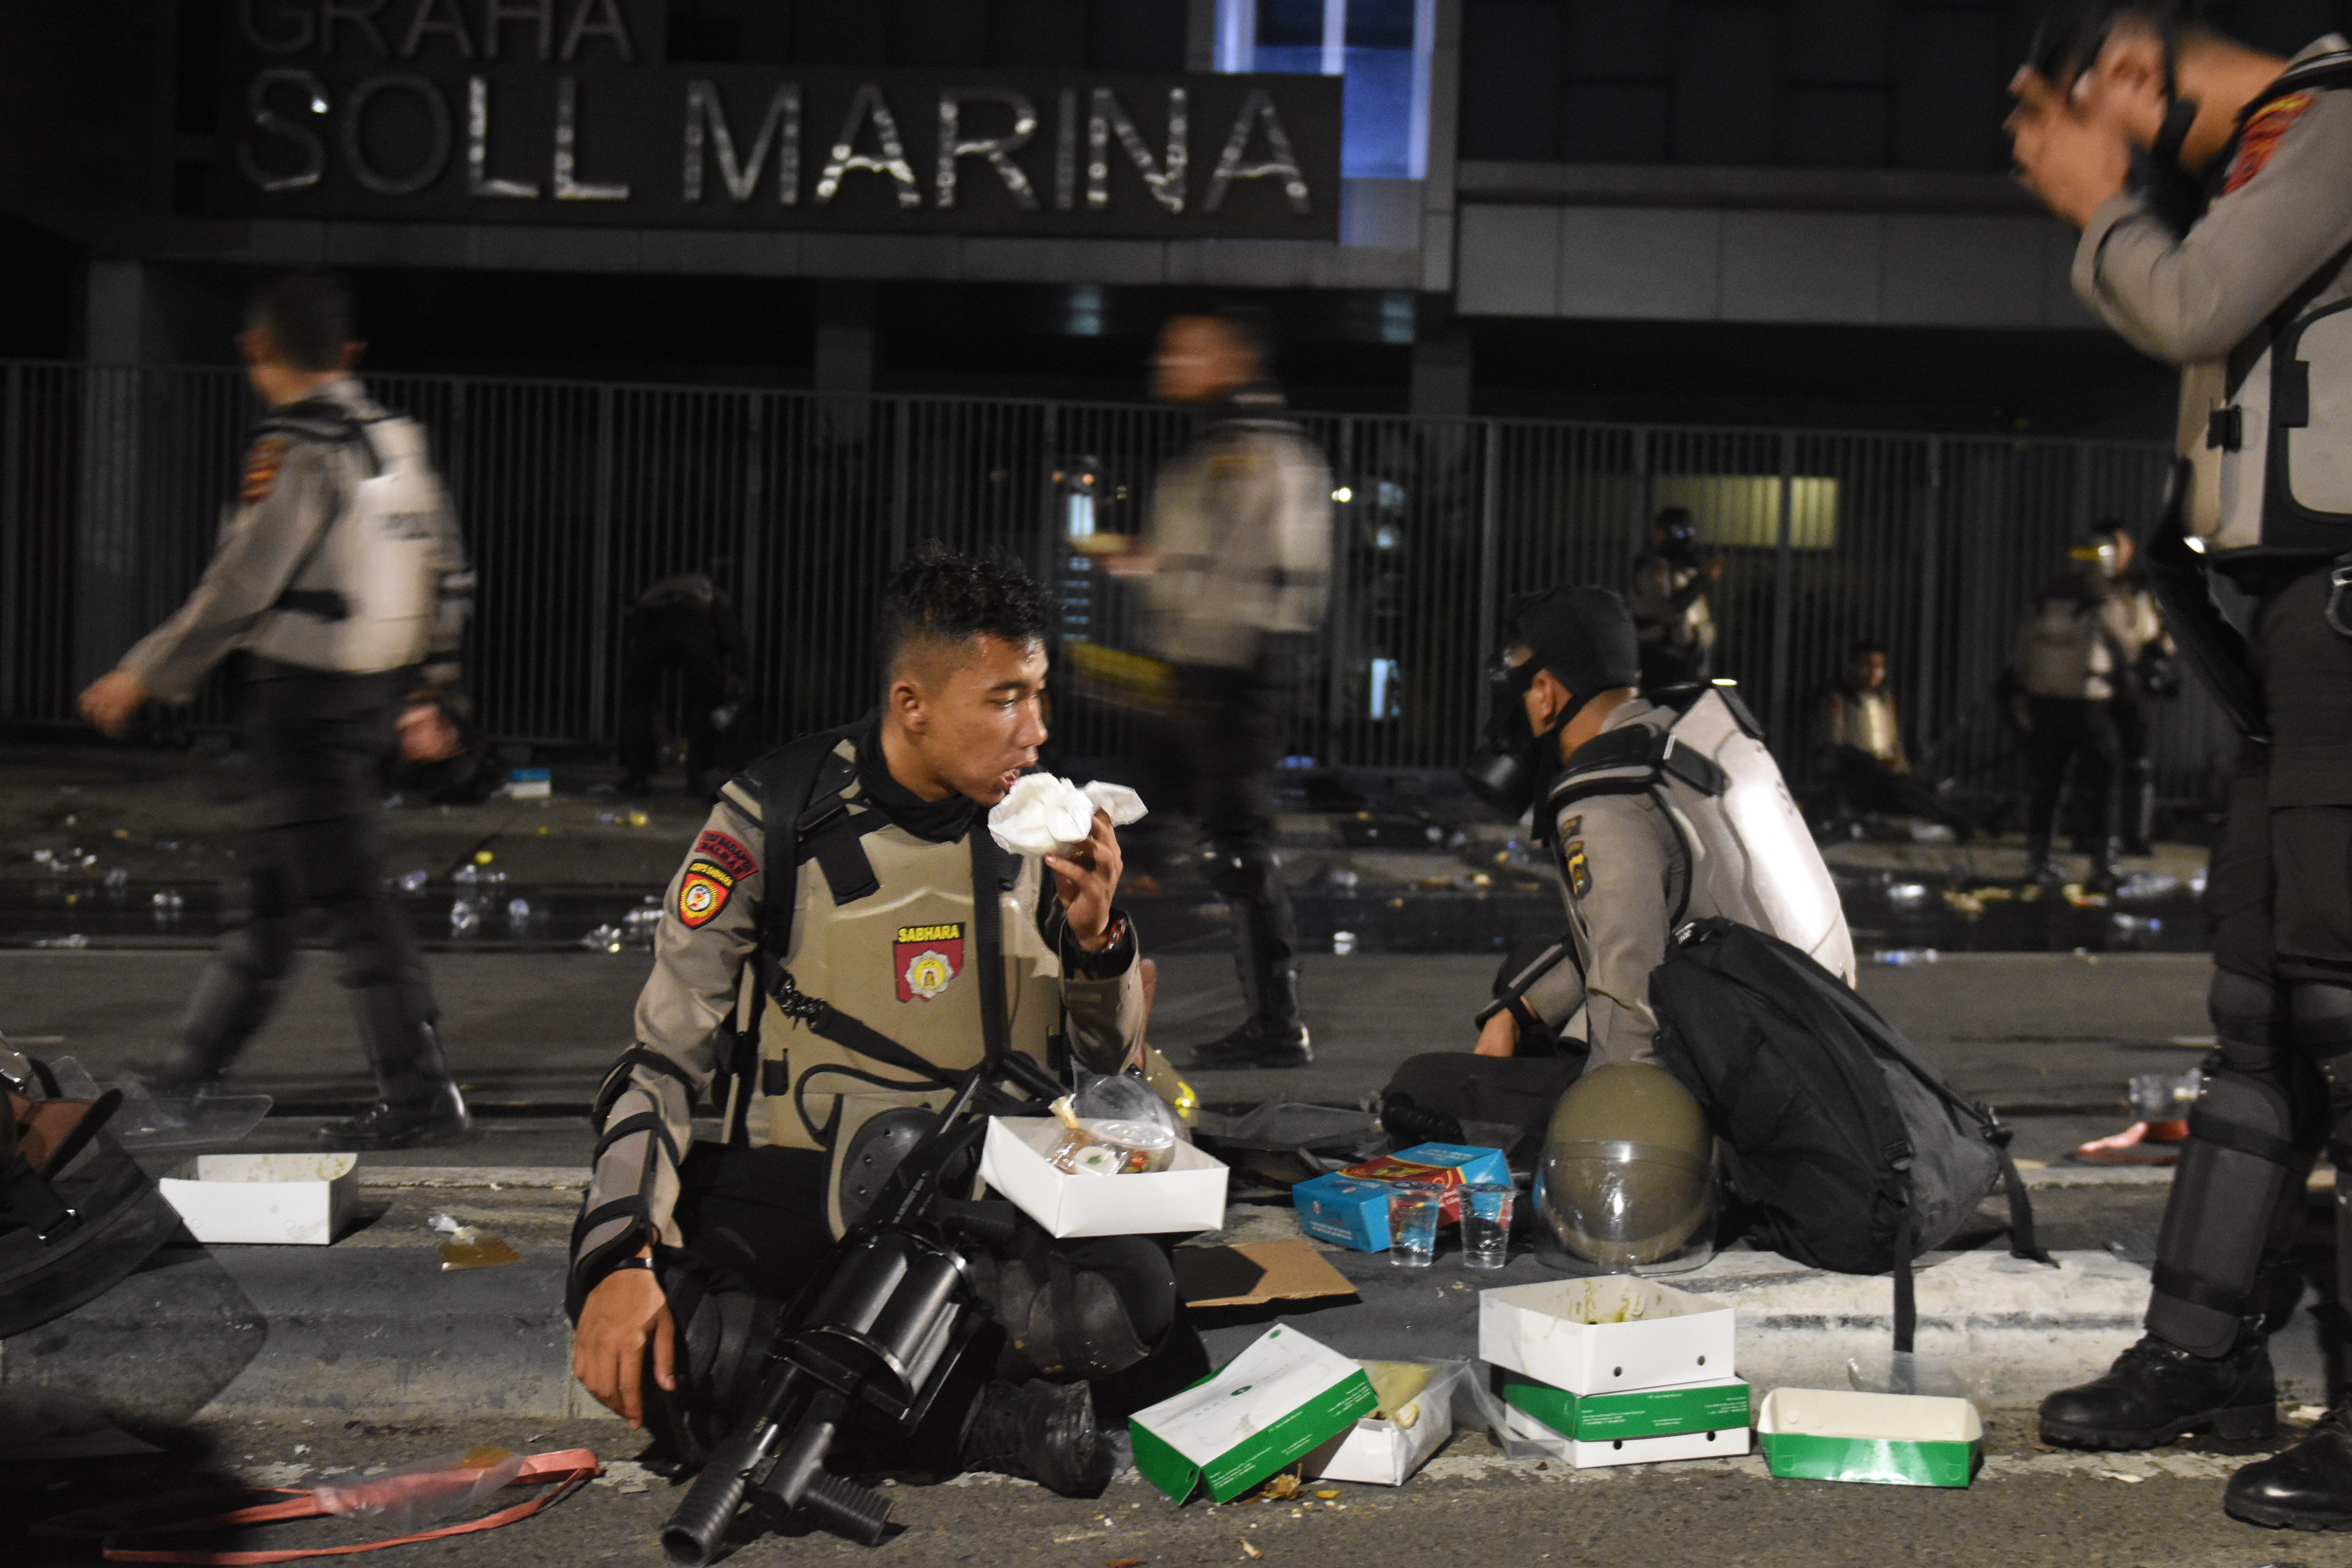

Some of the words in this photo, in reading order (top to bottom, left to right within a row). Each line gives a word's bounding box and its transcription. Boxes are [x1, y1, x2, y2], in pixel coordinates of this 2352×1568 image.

[236, 66, 631, 201] SOLL
[683, 80, 1312, 214] MARINA
[898, 924, 960, 942] SABHARA
